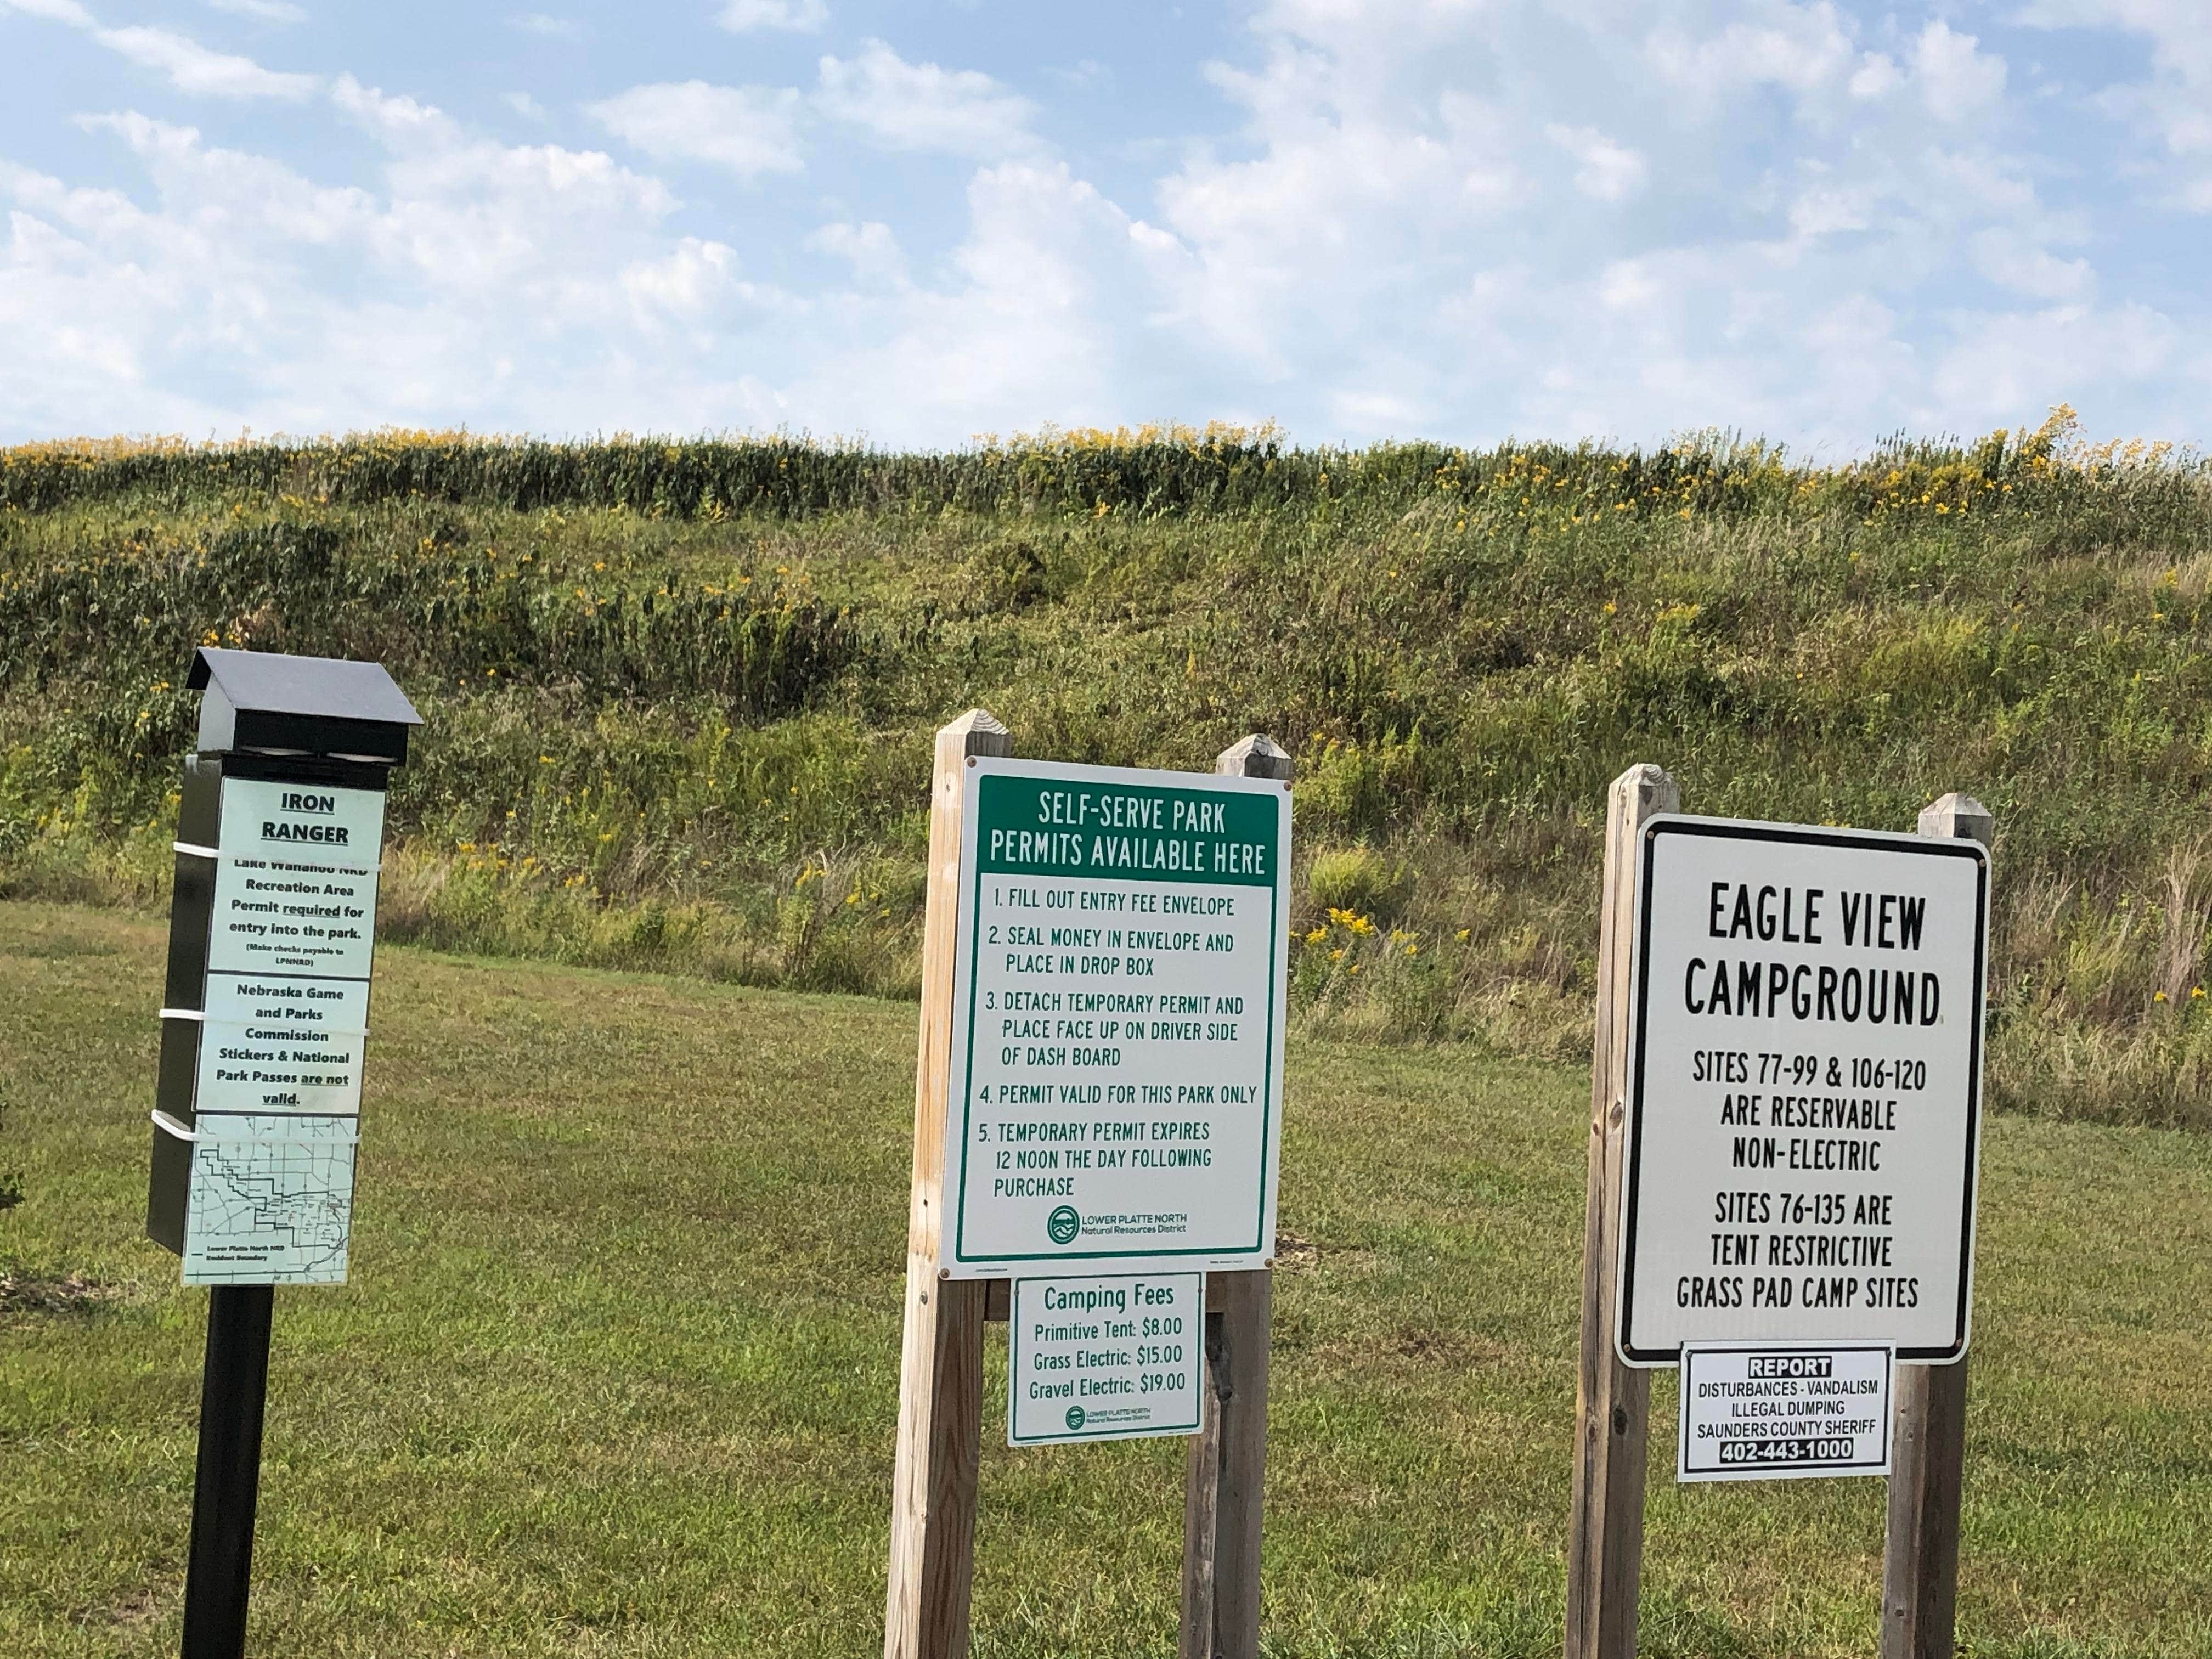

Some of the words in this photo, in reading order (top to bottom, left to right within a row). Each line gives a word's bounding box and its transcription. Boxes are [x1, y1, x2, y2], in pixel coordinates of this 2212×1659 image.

[281, 793, 335, 811] IRON
[1039, 791, 1163, 830] SELF-SERVE
[1173, 801, 1225, 833] PARK
[262, 822, 349, 843] RANGER
[991, 830, 1082, 865] PERMITS
[1091, 836, 1204, 871] AVAILABLE
[1215, 843, 1265, 874] HERE
[246, 879, 319, 894] Recreation
[324, 884, 353, 896] Area
[232, 900, 279, 912] Permit
[283, 905, 340, 918] required
[344, 906, 364, 917] for
[996, 888, 1002, 906] 1.
[1009, 889, 1040, 907] FILL
[1047, 890, 1075, 909] OUT
[1081, 892, 1126, 911] ENTRY
[1132, 894, 1156, 912] FEE
[1164, 896, 1234, 916] ENVELOPE
[1709, 882, 1823, 944] EAGLE
[1841, 892, 1925, 950] VIEW
[230, 923, 267, 935] entry
[271, 923, 298, 935] into
[303, 926, 324, 936] the
[328, 928, 361, 940] park.
[989, 926, 1001, 944] 2.
[1008, 927, 1044, 945] SEAL
[1051, 928, 1101, 947] MONEY
[1108, 930, 1121, 948] IN
[1128, 931, 1200, 951] ENVELOPE
[1206, 934, 1233, 952] AND
[1007, 954, 1053, 973] PLACE
[1060, 956, 1074, 973] IN
[1081, 956, 1120, 975] DROP
[1127, 958, 1153, 975] BOX
[238, 984, 302, 997] Nebraska
[307, 988, 343, 999] Game
[1685, 958, 1939, 1025] CAMPGROUND
[986, 991, 997, 1009] 3.
[1005, 992, 1060, 1011] DETACH
[1068, 994, 1153, 1013] TEMPORARY
[1160, 996, 1210, 1014] PERMIT
[1216, 997, 1243, 1014] AND
[256, 1008, 281, 1018] and
[286, 1008, 322, 1020] Parks
[246, 1028, 328, 1041] Commission
[1002, 1020, 1050, 1038] PLACE
[1057, 1020, 1093, 1039] FACE
[1100, 1021, 1119, 1039] UP
[1126, 1022, 1144, 1039] ON
[1152, 1022, 1201, 1040] DRIVER
[1207, 1023, 1237, 1041] SIDE
[219, 1048, 274, 1060] Stickers
[278, 1051, 287, 1061] &
[293, 1052, 349, 1063] National
[1002, 1047, 1020, 1065] OF
[1027, 1047, 1065, 1065] DASH
[1073, 1048, 1120, 1066] BOARD
[217, 1070, 248, 1081] Park
[253, 1071, 297, 1083] Passes
[301, 1075, 322, 1084] are
[326, 1075, 349, 1085] not
[1693, 1051, 1748, 1083] SITES
[1758, 1053, 1817, 1085] 77-99
[1826, 1057, 1841, 1087] &
[1852, 1058, 1926, 1090] 106-120
[263, 1093, 300, 1106] valid.
[980, 1085, 992, 1103] 4.
[1000, 1085, 1054, 1103] PERMIT
[1060, 1086, 1101, 1103] VALID
[1108, 1086, 1135, 1103] FOR
[1142, 1086, 1172, 1103] THIS
[1178, 1086, 1214, 1103] PARK
[1221, 1086, 1256, 1103] ONLY
[1721, 1094, 1761, 1125] ARE
[1771, 1096, 1897, 1130] RESERVABLE
[979, 1124, 990, 1142] 5.
[998, 1123, 1087, 1142] TEMPORARY
[1094, 1123, 1146, 1141] PERMIT
[1152, 1122, 1209, 1140] EXPIRES
[997, 1151, 1010, 1169] 12
[1017, 1150, 1058, 1169] NOON
[1065, 1150, 1091, 1168] THE
[1098, 1150, 1126, 1167] DAY
[1132, 1149, 1211, 1167] FOLLOWING
[1733, 1137, 1880, 1171] NON-ELECTRIC
[995, 1177, 1074, 1197] PURCHASE
[1715, 1192, 1770, 1223] SITES
[1781, 1194, 1845, 1224] 76-135
[1854, 1195, 1892, 1225] ARE
[1082, 1216, 1116, 1225] LOWER
[1119, 1215, 1153, 1224] PLATTE
[1155, 1214, 1187, 1223] NORTH
[1158, 1224, 1186, 1233] District
[1712, 1234, 1759, 1265] TENT
[1769, 1235, 1892, 1266] RESTRICTIVE
[1045, 1285, 1125, 1314] Camping
[1135, 1284, 1173, 1305] Fees
[1678, 1277, 1743, 1307] GRASS
[1753, 1277, 1792, 1307] PAD
[1803, 1277, 1858, 1307] CAMP
[1866, 1278, 1918, 1307] SITES
[1036, 1322, 1098, 1341] Primitive
[1104, 1321, 1136, 1338] Tent:
[1143, 1317, 1182, 1338] $8.00
[1035, 1353, 1071, 1370] Grass
[1077, 1348, 1131, 1368] Electric:
[1137, 1345, 1182, 1366] $15.00
[1750, 1358, 1830, 1376] REPORT
[1030, 1380, 1073, 1399] Gravel
[1080, 1376, 1134, 1396] Electric:
[1141, 1373, 1184, 1394] $19.00
[1699, 1381, 1797, 1397] DISTURBANCES
[1807, 1380, 1877, 1395] VANDALISM
[1732, 1402, 1784, 1417] ILLEGAL
[1788, 1401, 1844, 1415] DUMPING
[1698, 1423, 1767, 1438] SAUNDERS
[1771, 1421, 1822, 1436] COUNTY
[1825, 1419, 1876, 1435] SHERIFF
[1721, 1440, 1852, 1462] 402-443-1000
